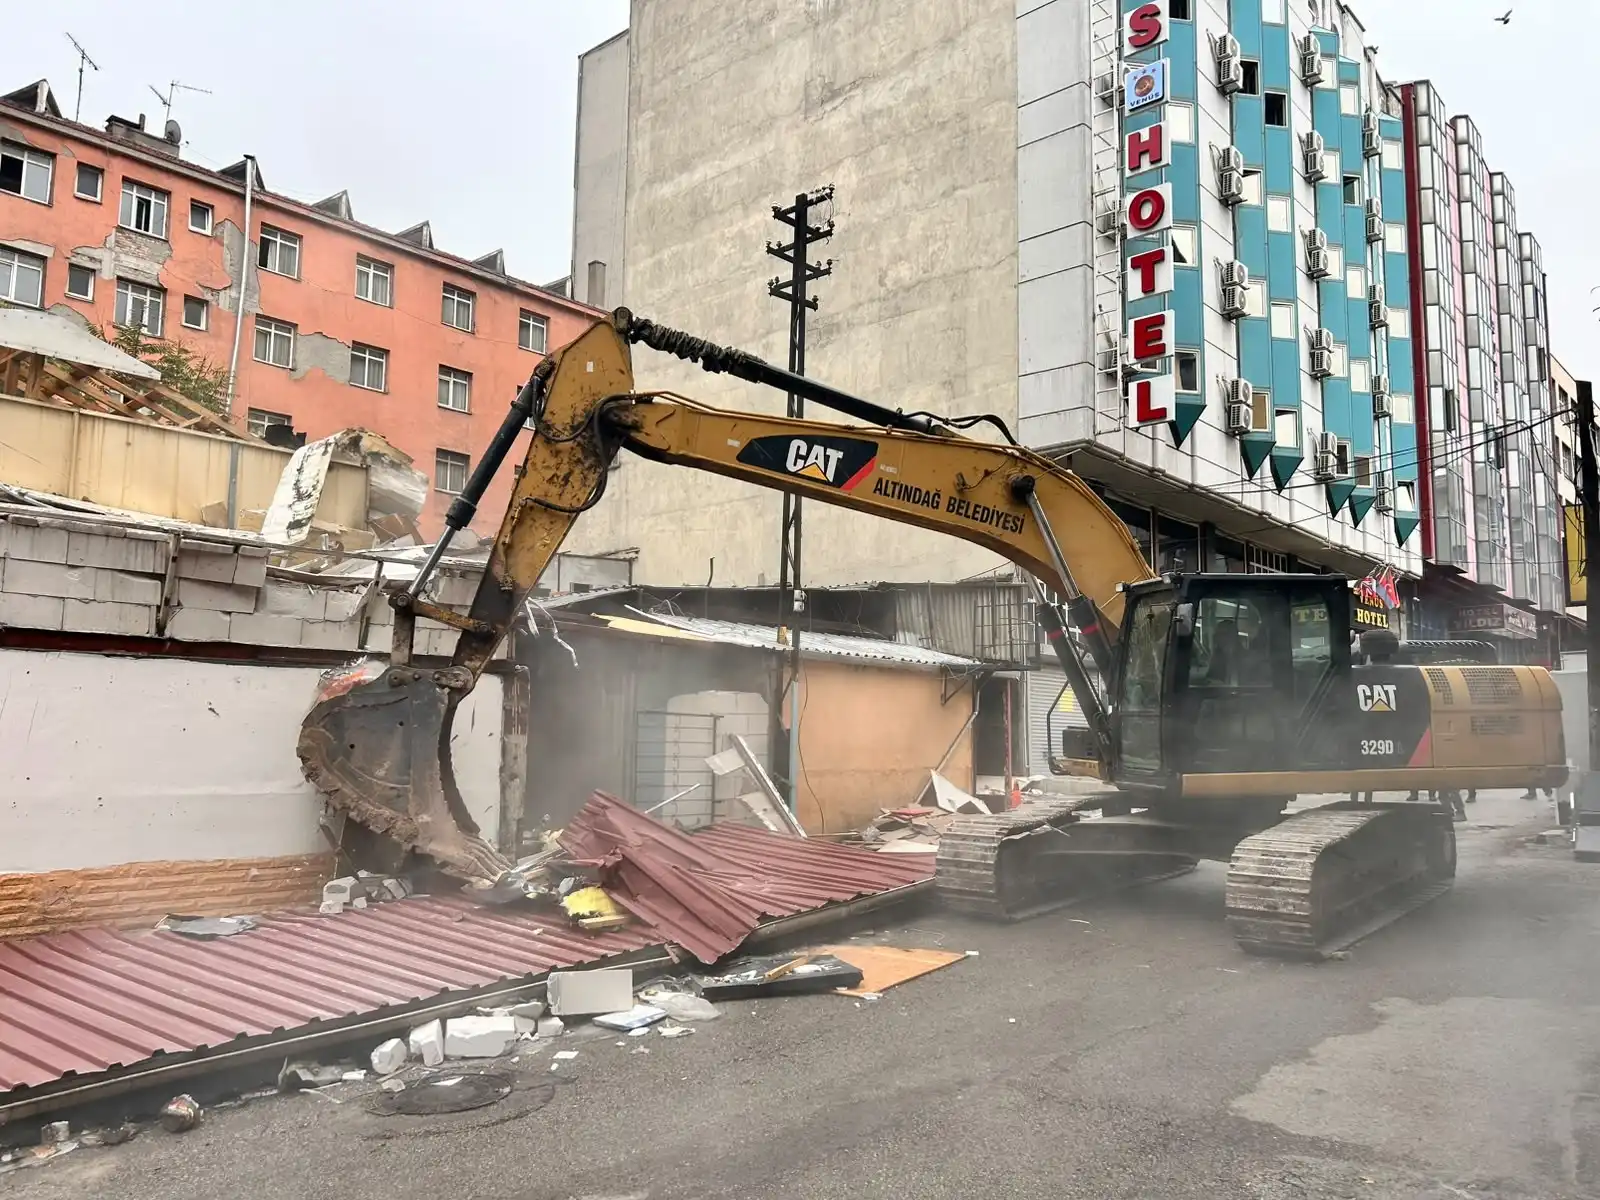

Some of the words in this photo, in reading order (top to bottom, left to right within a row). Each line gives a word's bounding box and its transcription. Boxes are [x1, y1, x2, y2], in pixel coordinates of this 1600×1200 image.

[1128, 123, 1168, 424] HOTEL
[785, 438, 844, 483] CAT
[872, 477, 942, 510] ALTINDAĞ
[946, 495, 1026, 535] BELEDİYESİ
[1356, 608, 1389, 628] HOTEL
[1356, 684, 1397, 712] CAT
[1360, 739, 1394, 755] 329D
